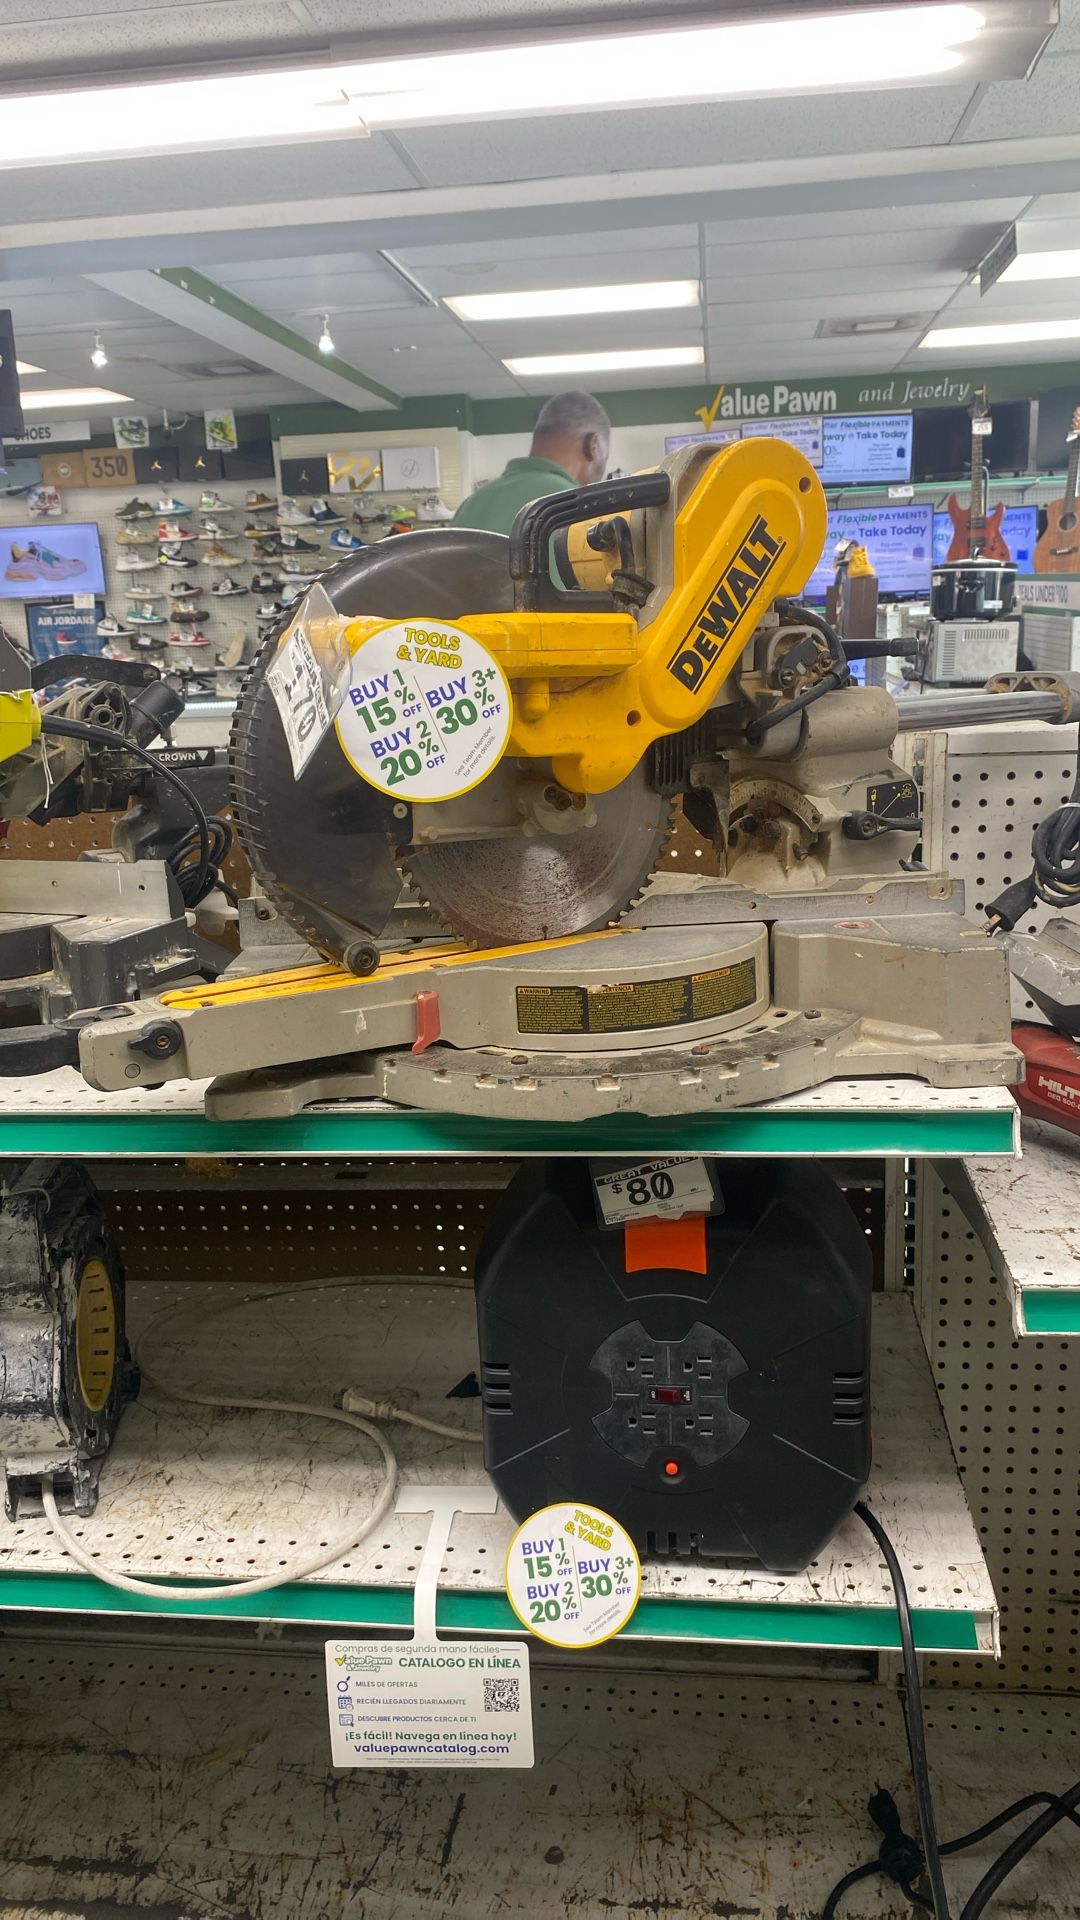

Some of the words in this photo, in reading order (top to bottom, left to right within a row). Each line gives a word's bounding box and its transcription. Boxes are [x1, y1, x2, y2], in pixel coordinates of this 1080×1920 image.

[859, 382, 894, 402] and
[901, 378, 970, 404] Jewelry
[840, 419, 870, 430] Flexible
[872, 419, 909, 427] PAYMENTS
[15, 427, 51, 441] HOES
[856, 432, 878, 440] Take
[880, 430, 908, 440] Today
[90, 455, 128, 478] 350
[838, 512, 877, 525] Flexible
[878, 510, 928, 521] PAYMENTS
[859, 526, 888, 538] Take
[890, 524, 928, 537] Today
[1001, 526, 1031, 538] oday
[38, 616, 53, 626] AIR
[54, 615, 95, 626] JORDANS
[405, 627, 460, 650] TOOLS
[396, 644, 411, 661] &
[414, 647, 462, 669] YARD
[349, 674, 390, 706] BUY
[393, 669, 405, 686] 1
[425, 676, 467, 708] BUY
[472, 668, 496, 687] 3+
[403, 703, 422, 718] OFF
[482, 704, 502, 719] OFF
[370, 727, 411, 758] BUY
[416, 720, 431, 738] 2
[463, 749, 476, 765] Team
[474, 726, 492, 750] Member
[159, 752, 196, 762] CROWN
[426, 754, 446, 769] OFF
[469, 753, 482, 769] more
[1038, 1075, 1080, 1101] HILT
[604, 1169, 642, 1183] GREAT
[612, 1172, 674, 1205] $80
[574, 1509, 614, 1537] TOOLS
[564, 1521, 575, 1535] &
[577, 1526, 611, 1551] YARD
[522, 1539, 555, 1555] BUY
[558, 1538, 565, 1551] 1
[557, 1567, 573, 1576] OFF
[577, 1558, 611, 1574] BUY
[615, 1556, 634, 1570] 3+
[527, 1583, 560, 1599] BUY
[564, 1581, 574, 1595] 2
[615, 1586, 632, 1595] OFF
[564, 1612, 580, 1620] OFF
[335, 1645, 379, 1654] Compras
[395, 1645, 437, 1655] segunda
[469, 1645, 500, 1653] fáciles
[399, 1657, 466, 1668] CATALOGO
[469, 1658, 484, 1667] EN
[488, 1655, 521, 1668] LÍNEA
[345, 1732, 361, 1741] ¡Es
[363, 1731, 392, 1740] fácil!
[395, 1732, 440, 1742] Navega
[459, 1731, 488, 1740] línea
[491, 1731, 517, 1743] hoy!
[354, 1744, 510, 1755] valuepawncatalog.com
